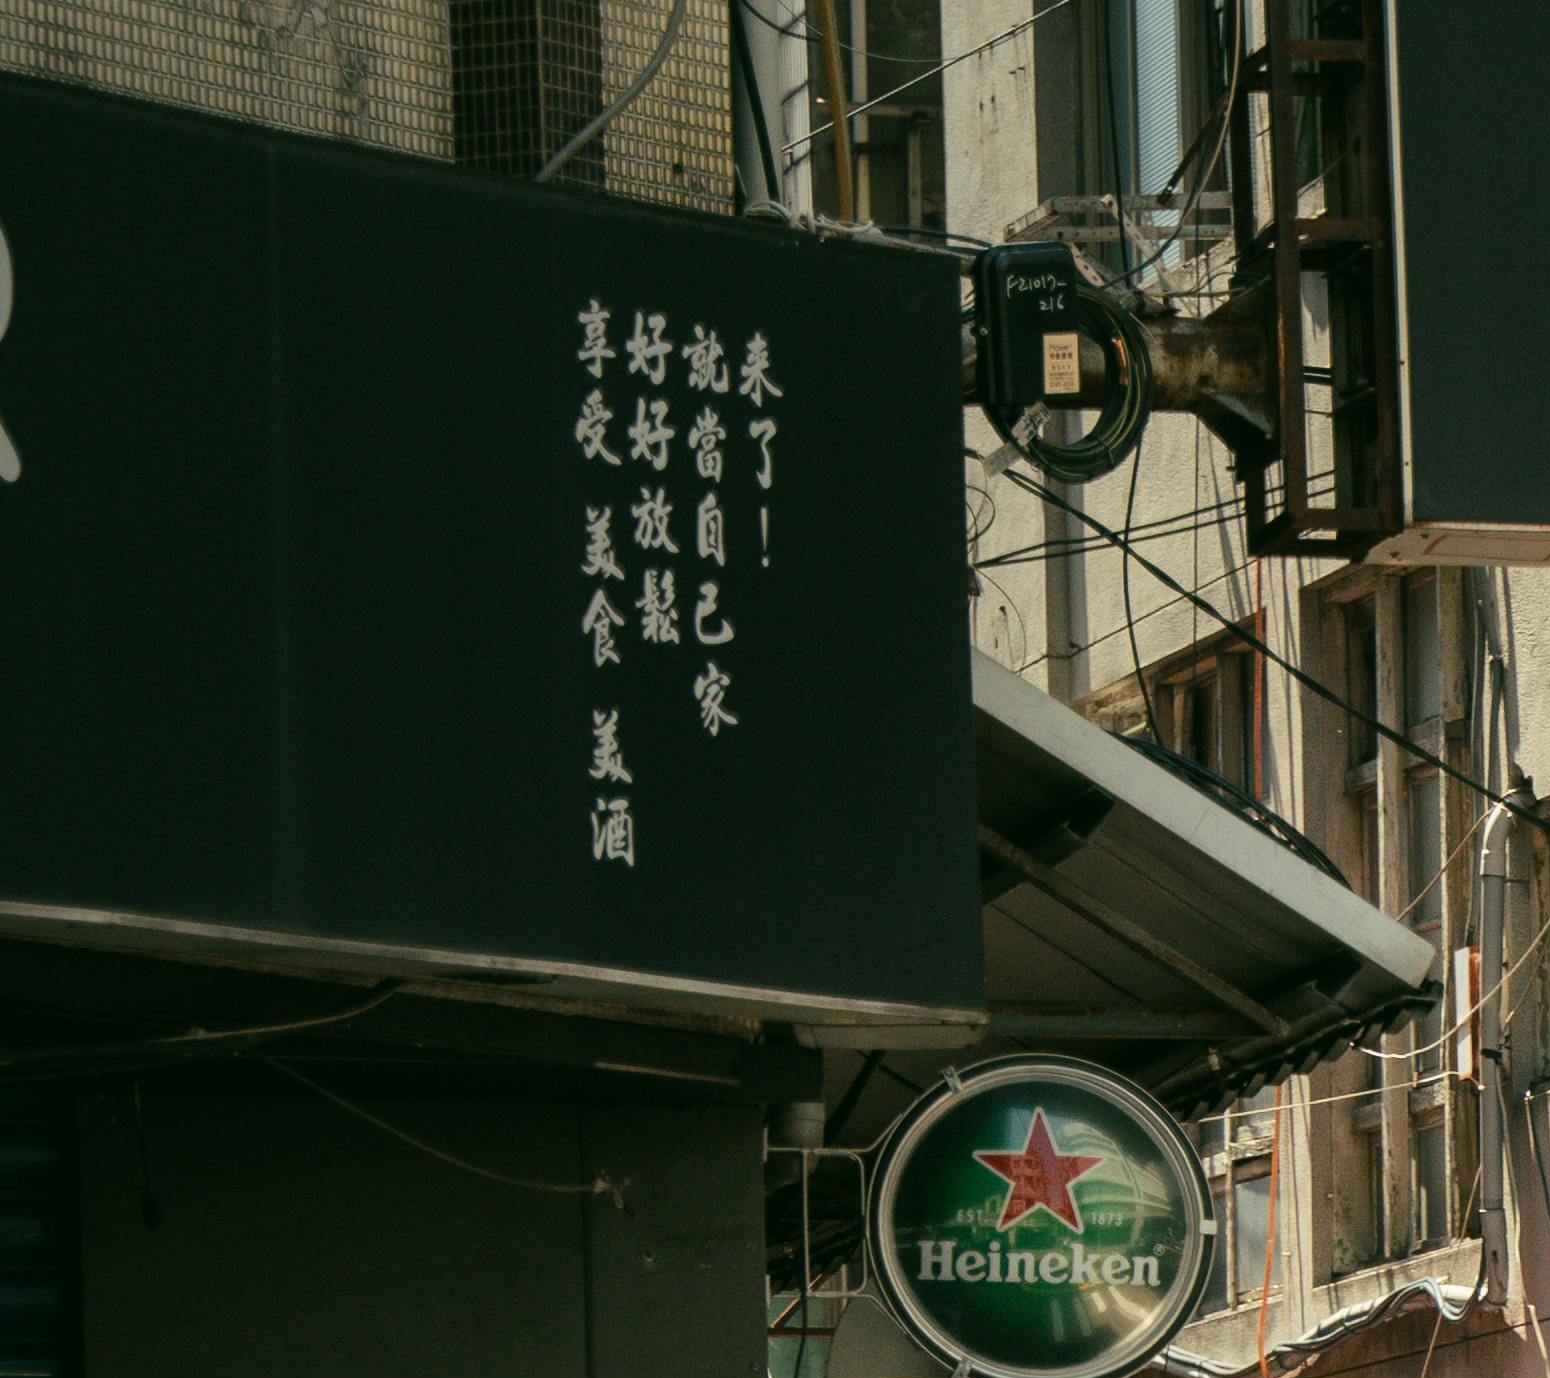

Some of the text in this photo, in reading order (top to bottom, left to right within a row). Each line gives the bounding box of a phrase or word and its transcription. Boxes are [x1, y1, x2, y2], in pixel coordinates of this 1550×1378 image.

[574, 300, 635, 868] 享受 美食 美酒
[626, 311, 680, 645] 好好放鬆
[917, 1240, 1162, 1287] Heineken
